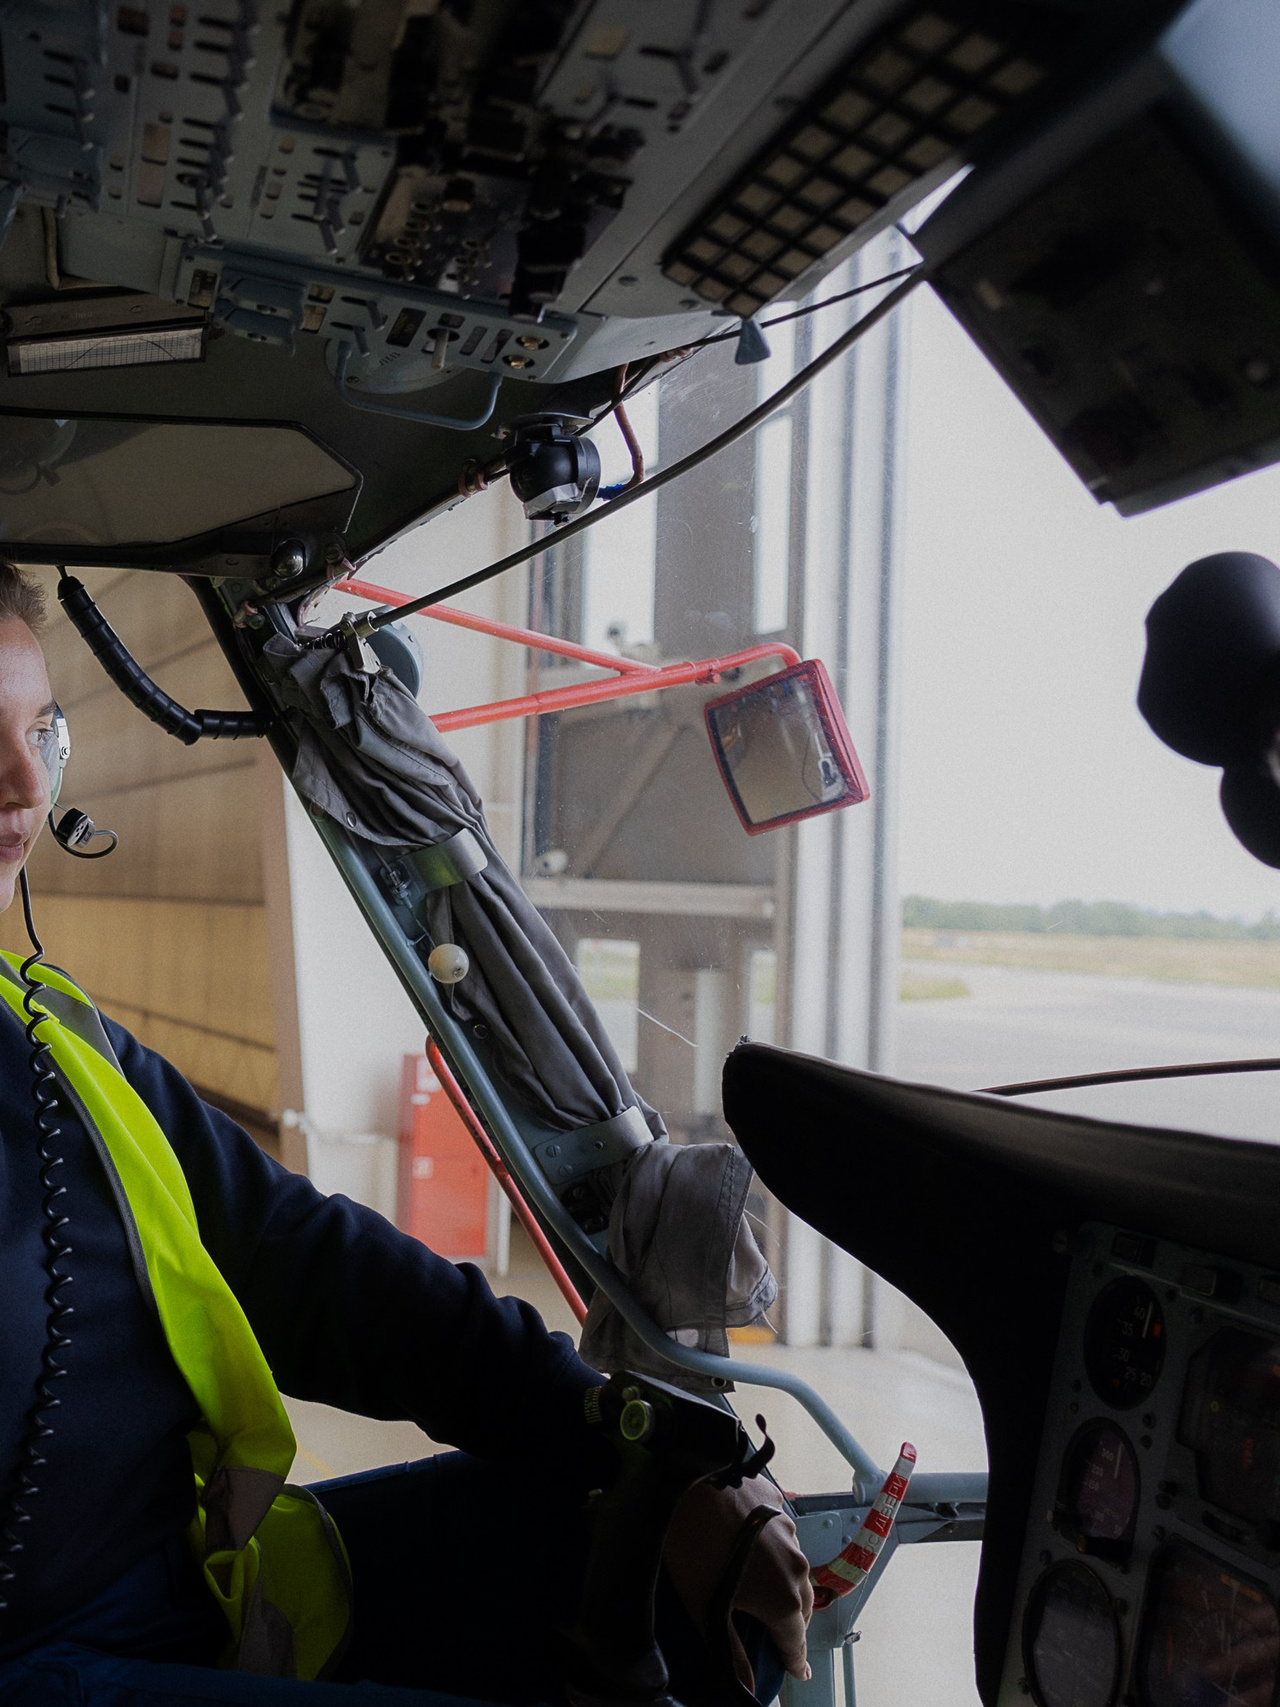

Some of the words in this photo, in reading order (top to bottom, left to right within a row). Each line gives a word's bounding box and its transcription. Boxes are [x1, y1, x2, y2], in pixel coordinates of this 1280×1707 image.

[1132, 1305, 1146, 1320] 40
[1121, 1320, 1134, 1337] 35
[1118, 1346, 1130, 1362] 30
[1124, 1365, 1137, 1381] 25
[1139, 1371, 1152, 1388] 20
[875, 1474, 907, 1532] ДВЕРИ
